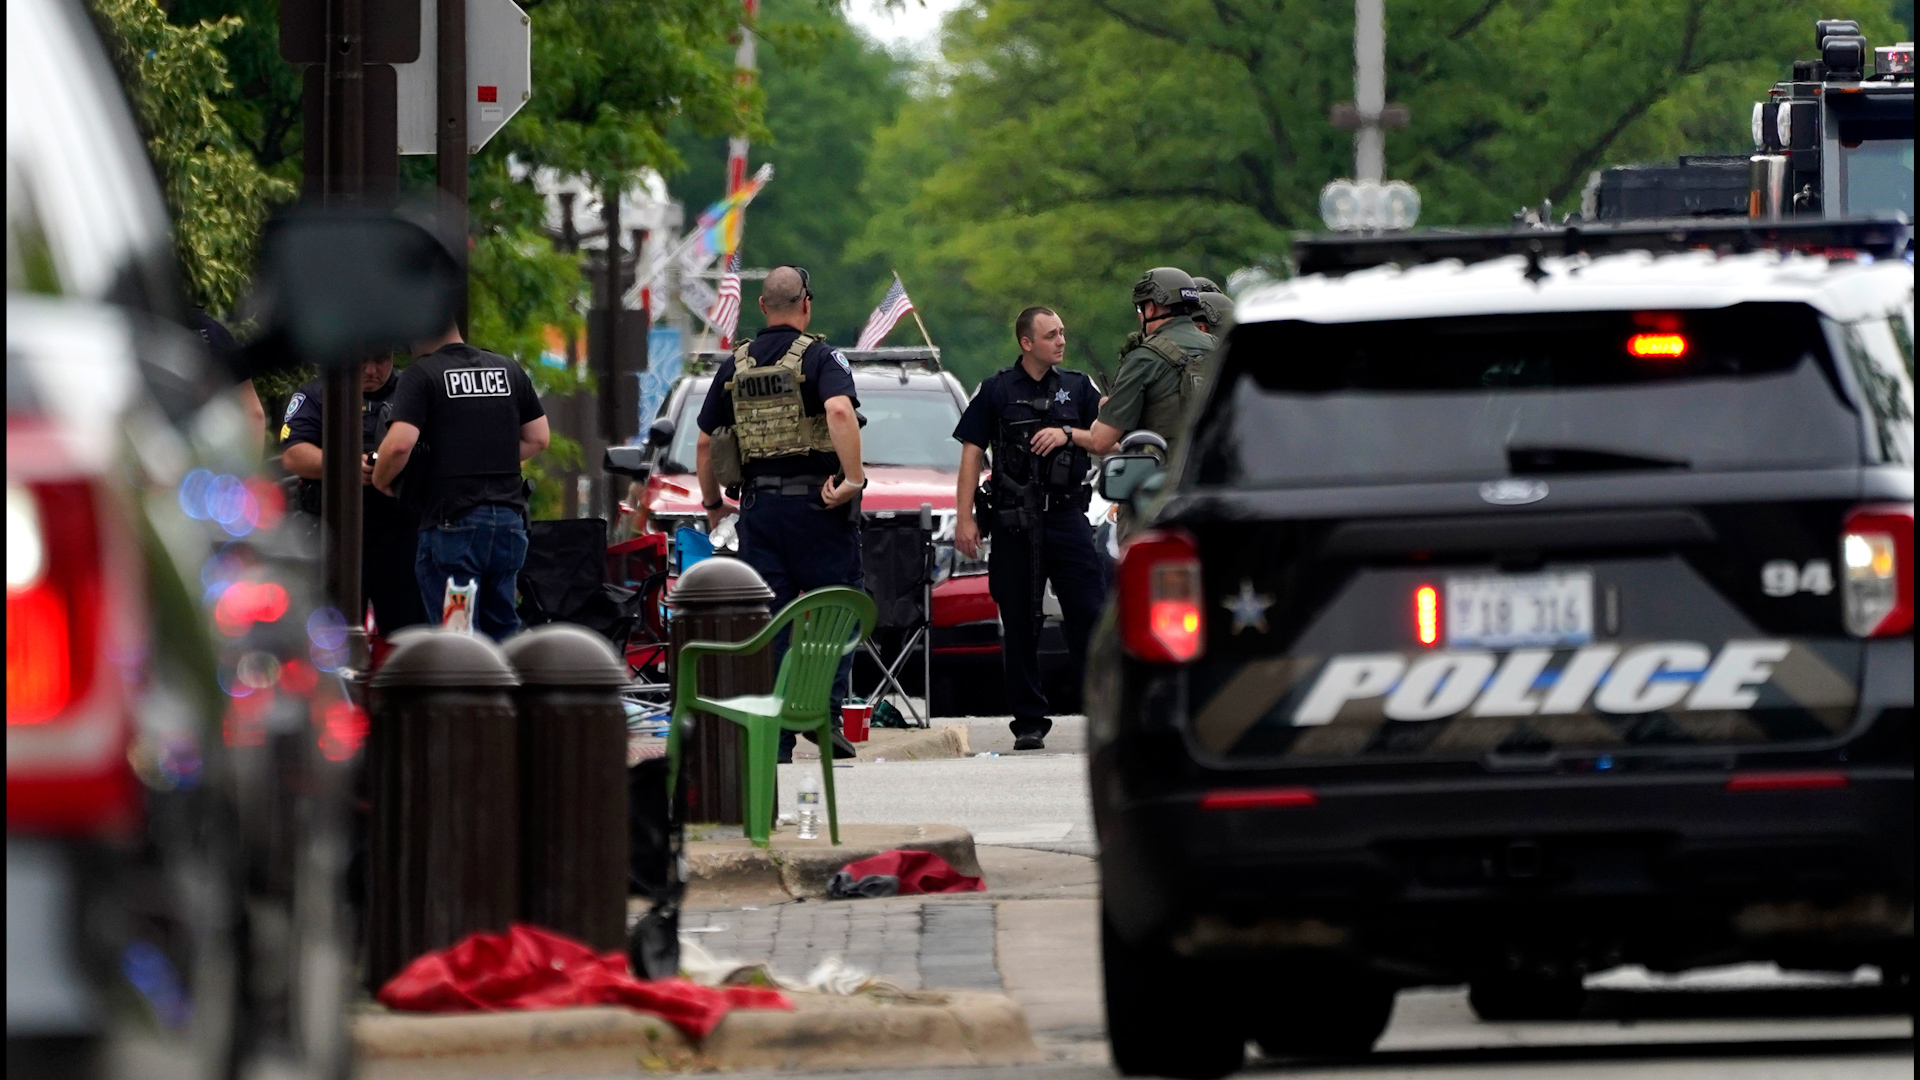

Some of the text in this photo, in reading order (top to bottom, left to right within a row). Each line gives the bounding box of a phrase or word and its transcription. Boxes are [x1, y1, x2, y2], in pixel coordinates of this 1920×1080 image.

[448, 371, 507, 395] POLICE
[1761, 559, 1834, 597] 94
[1293, 640, 1791, 727] POLICE
